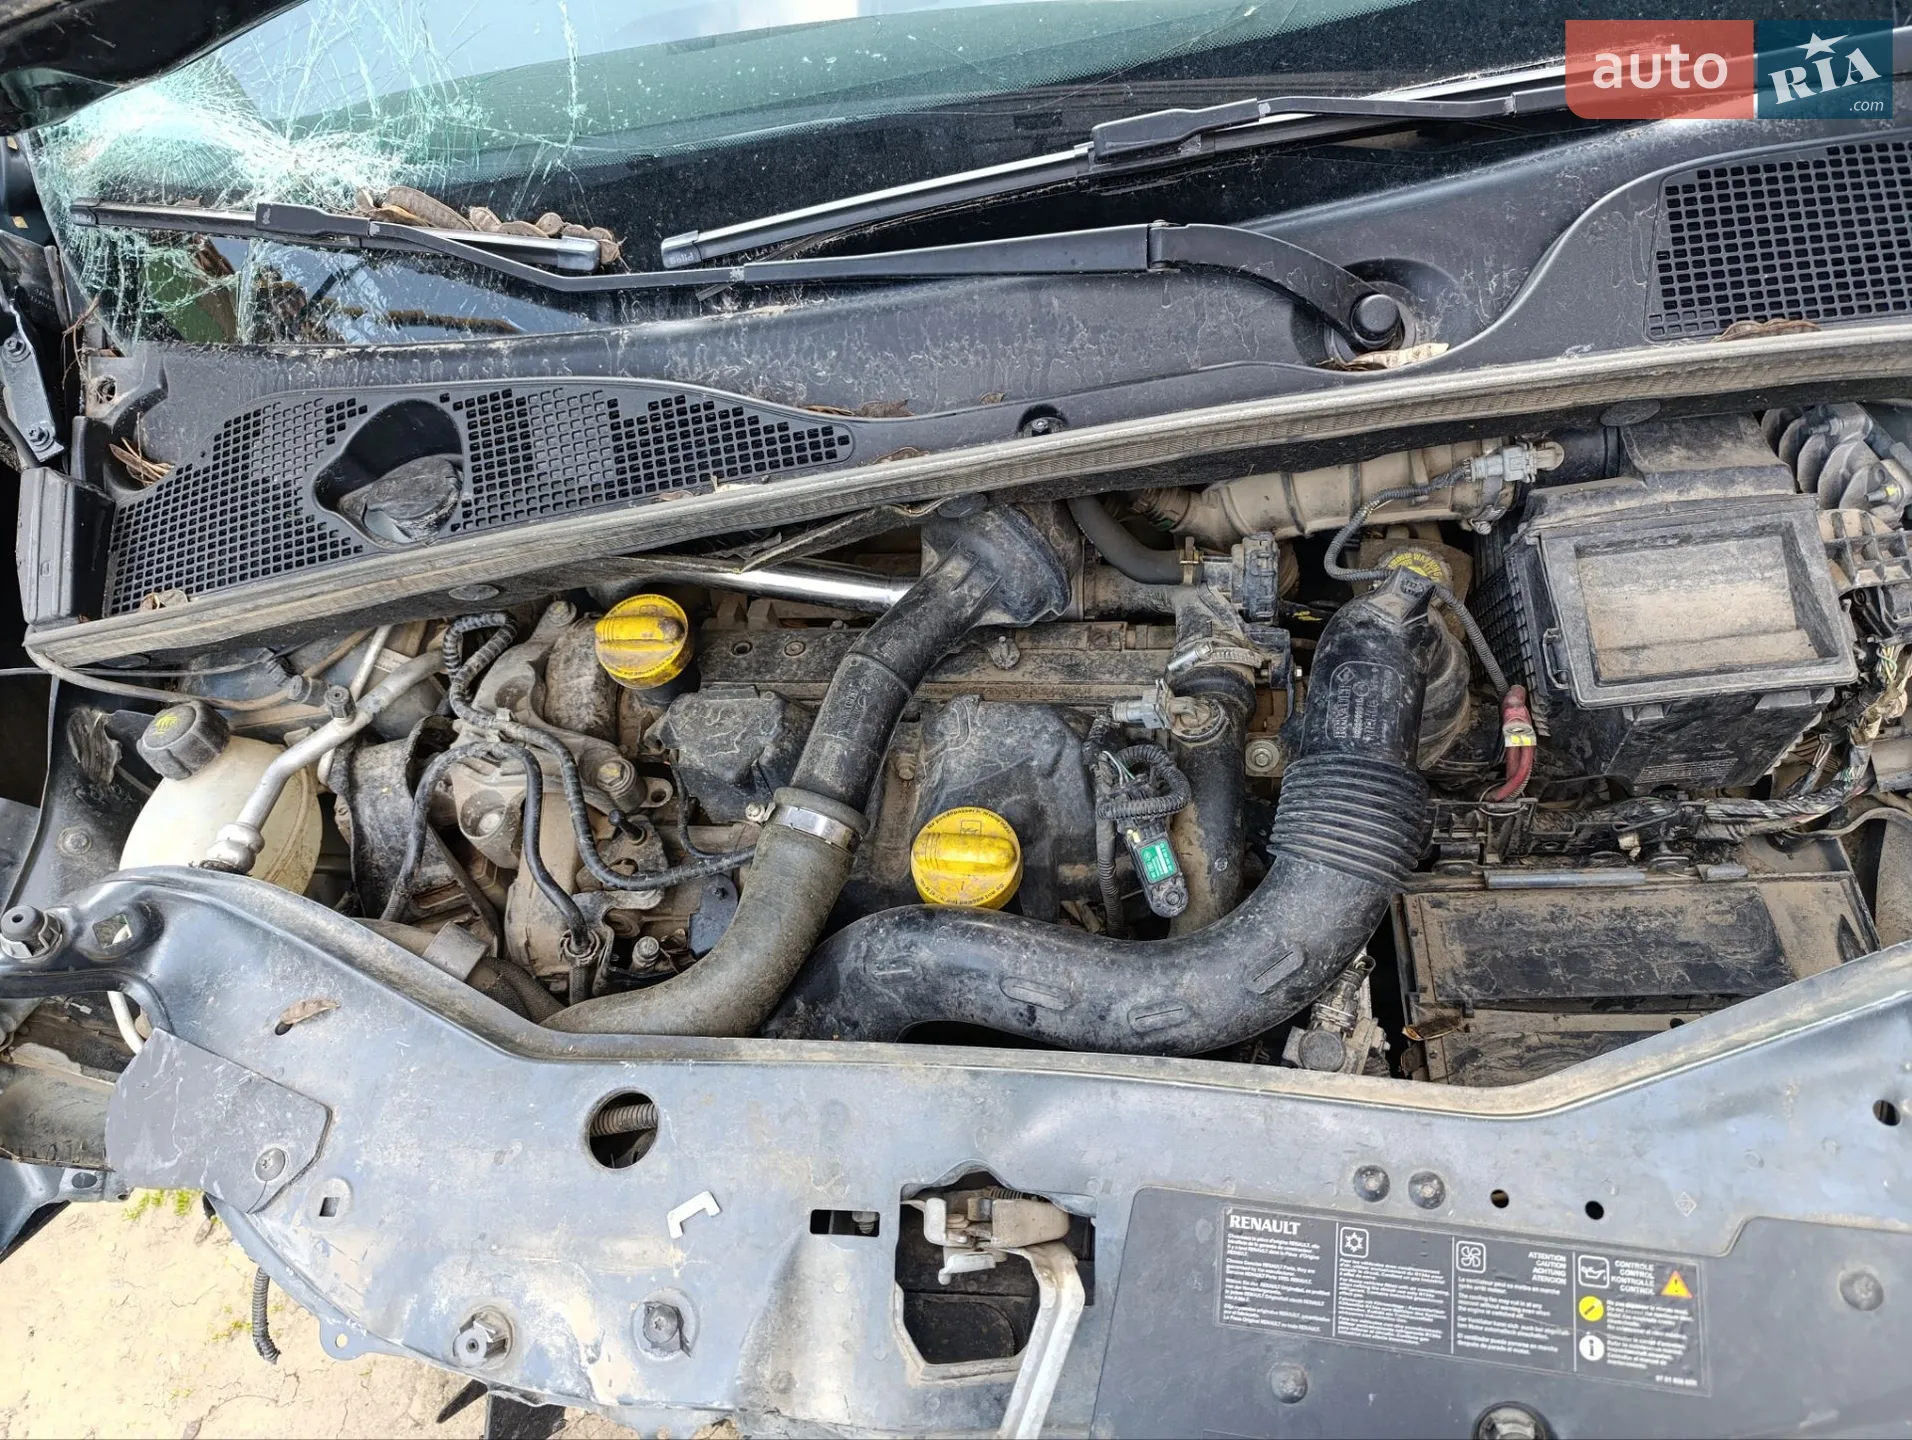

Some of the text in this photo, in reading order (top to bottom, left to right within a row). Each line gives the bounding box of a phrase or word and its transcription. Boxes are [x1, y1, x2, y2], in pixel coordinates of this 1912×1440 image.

[1229, 1214, 1301, 1235] RENAULT
[1528, 1251, 1566, 1262] ATTENTION
[1535, 1260, 1567, 1269] CAUTION
[1532, 1267, 1566, 1277] ACHTUNG
[1619, 1269, 1655, 1280] CONTROL
[1611, 1275, 1655, 1288] KONTROLLE
[1619, 1284, 1656, 1296] CONTROL
